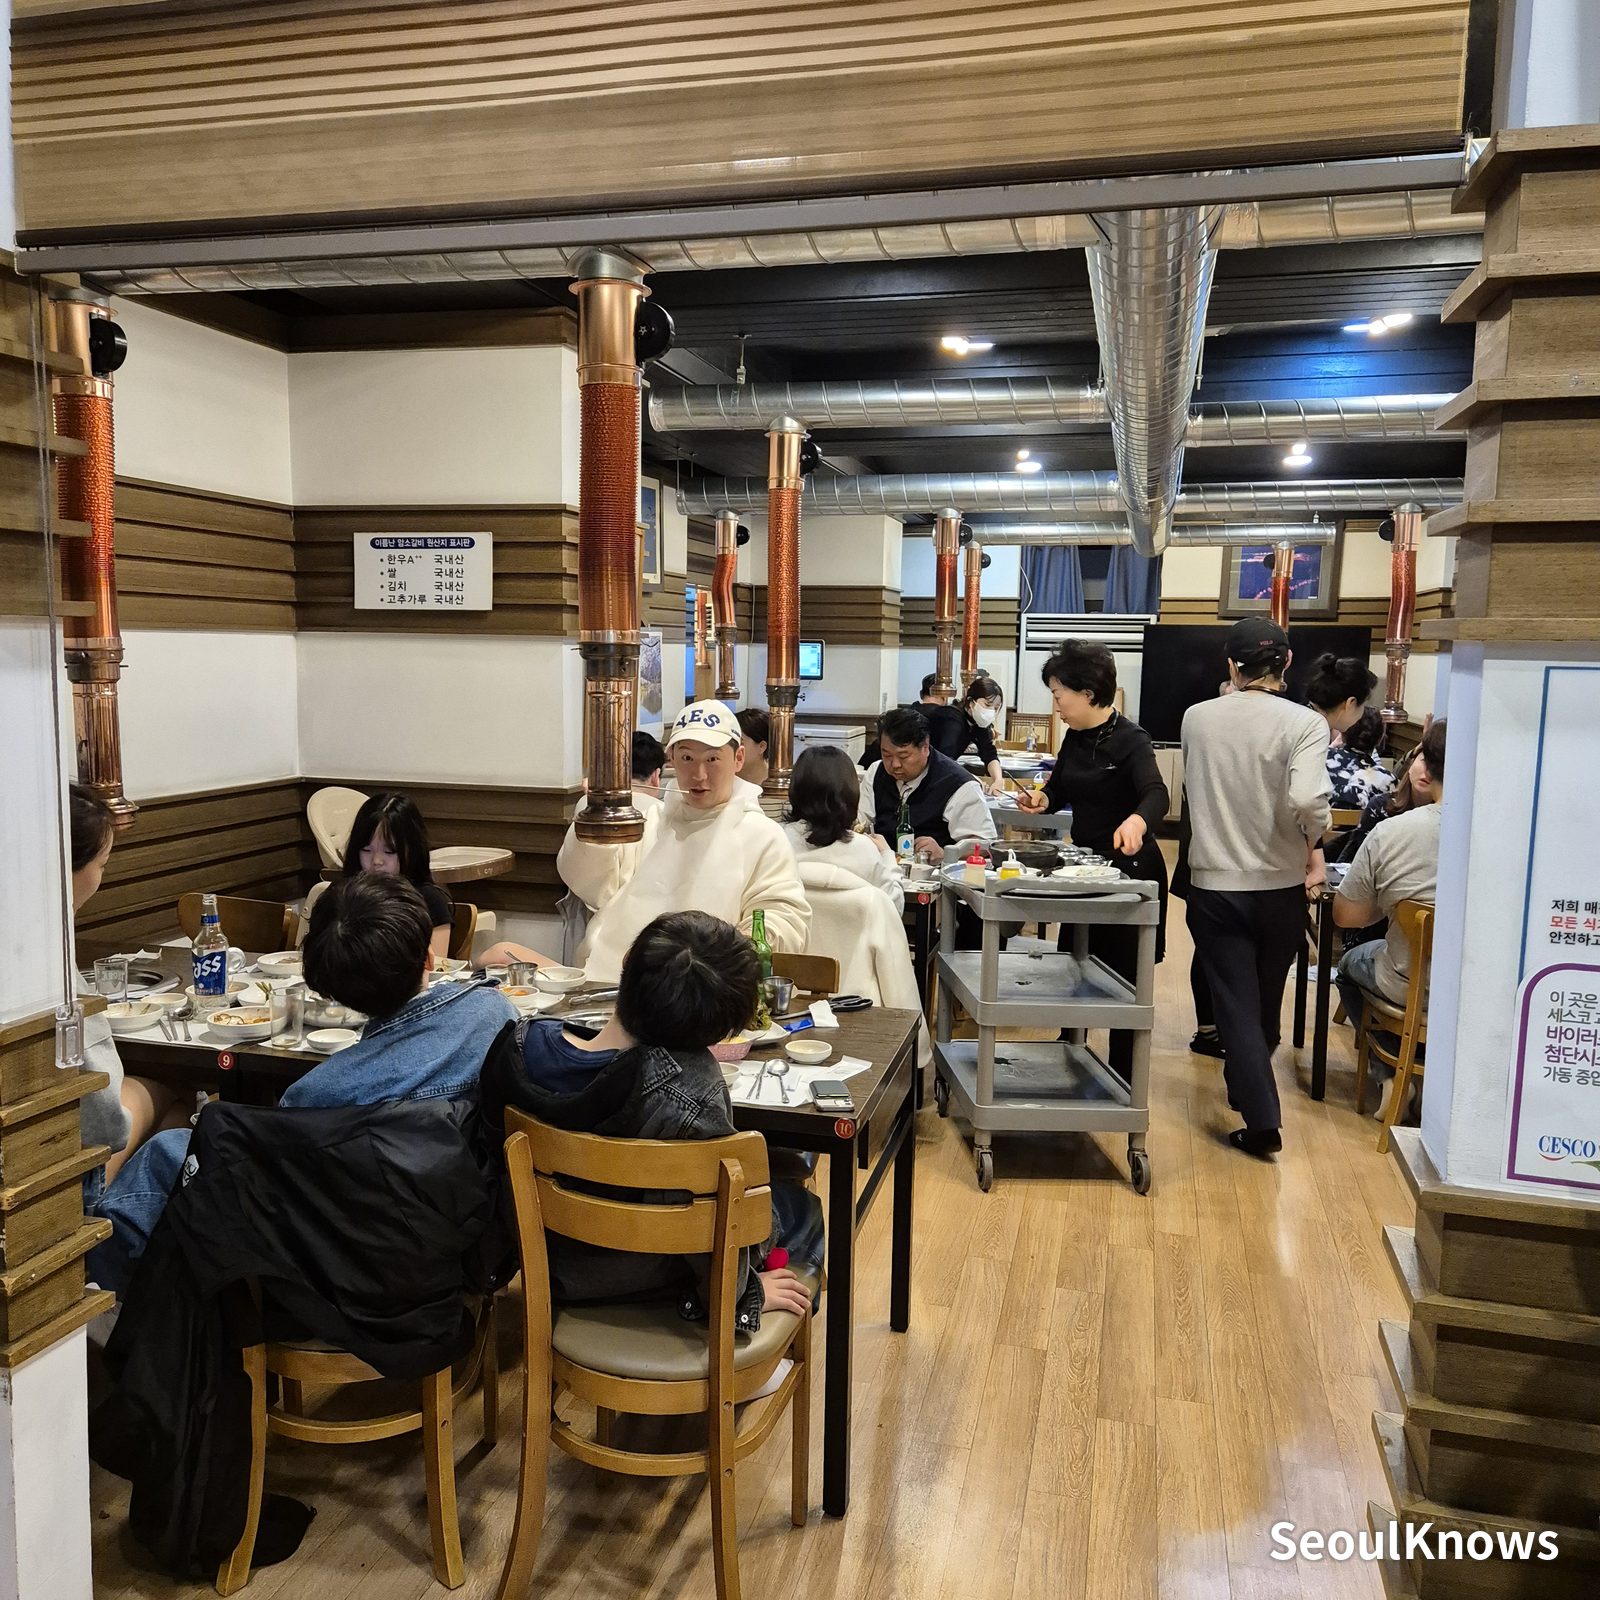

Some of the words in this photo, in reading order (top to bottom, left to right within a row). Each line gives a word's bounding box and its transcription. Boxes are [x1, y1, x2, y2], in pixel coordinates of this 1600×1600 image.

[375, 538, 396, 547] 이름난
[397, 538, 424, 547] 암소갈비
[427, 538, 447, 547] 원산지
[449, 538, 471, 547] 표시판
[434, 554, 464, 565] 국내산
[387, 567, 397, 578] 쌀
[434, 567, 464, 578] 국내산
[387, 581, 407, 591] 김치
[434, 581, 464, 591] 국내산
[387, 594, 427, 605] 고추가루
[434, 594, 464, 605] 국내산
[1551, 899, 1579, 913] 저희
[1584, 901, 1600, 914] 매
[1550, 915, 1577, 929] 모든
[1583, 917, 1600, 930] 식
[1550, 991, 1564, 1006] 이
[1568, 992, 1598, 1009] 곳은
[1547, 1008, 1591, 1024] 세스코
[1546, 1025, 1600, 1047] 바이러
[223, 1054, 230, 1066] 9
[1544, 1044, 1600, 1066] 첨단시
[1543, 1066, 1572, 1083] 가동
[1538, 1135, 1596, 1158] CESCO
